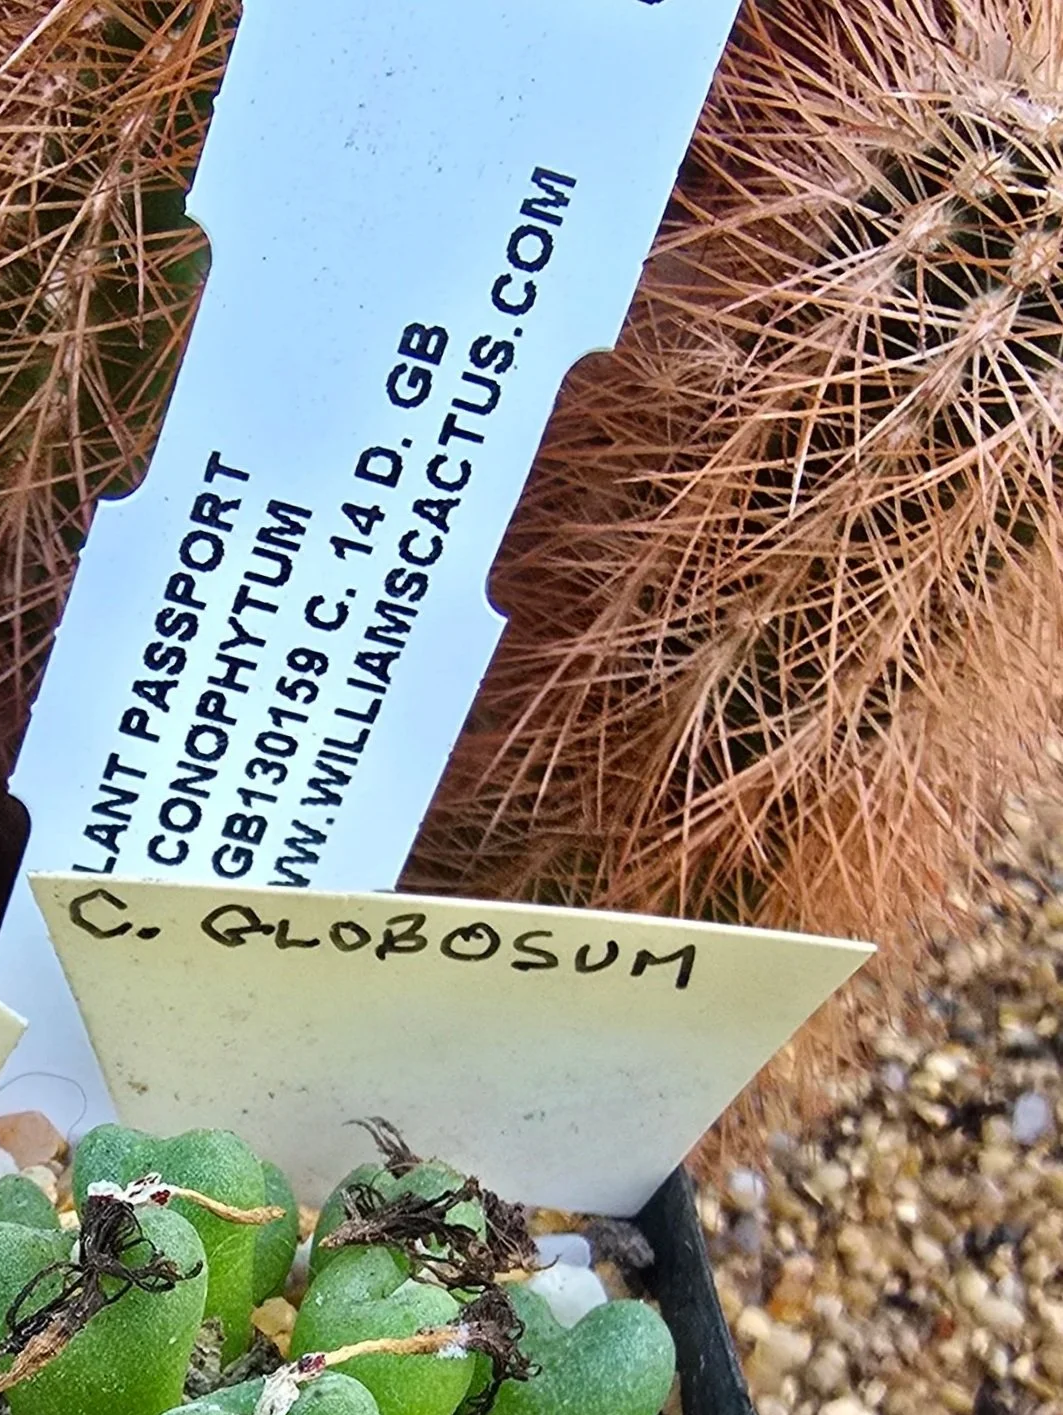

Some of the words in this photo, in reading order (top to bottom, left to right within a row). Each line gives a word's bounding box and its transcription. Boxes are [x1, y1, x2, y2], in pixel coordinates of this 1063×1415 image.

[386, 321, 449, 409] GB
[355, 437, 413, 490] D.
[329, 503, 386, 560] 14
[304, 589, 356, 632] C.
[73, 754, 147, 876] LANT
[118, 450, 250, 744] PASSPORT
[148, 500, 313, 868] CONOPHYTUM
[212, 646, 330, 880] GB130159
[69, 889, 161, 941] C.
[200, 904, 697, 990] GLOBOSUM
